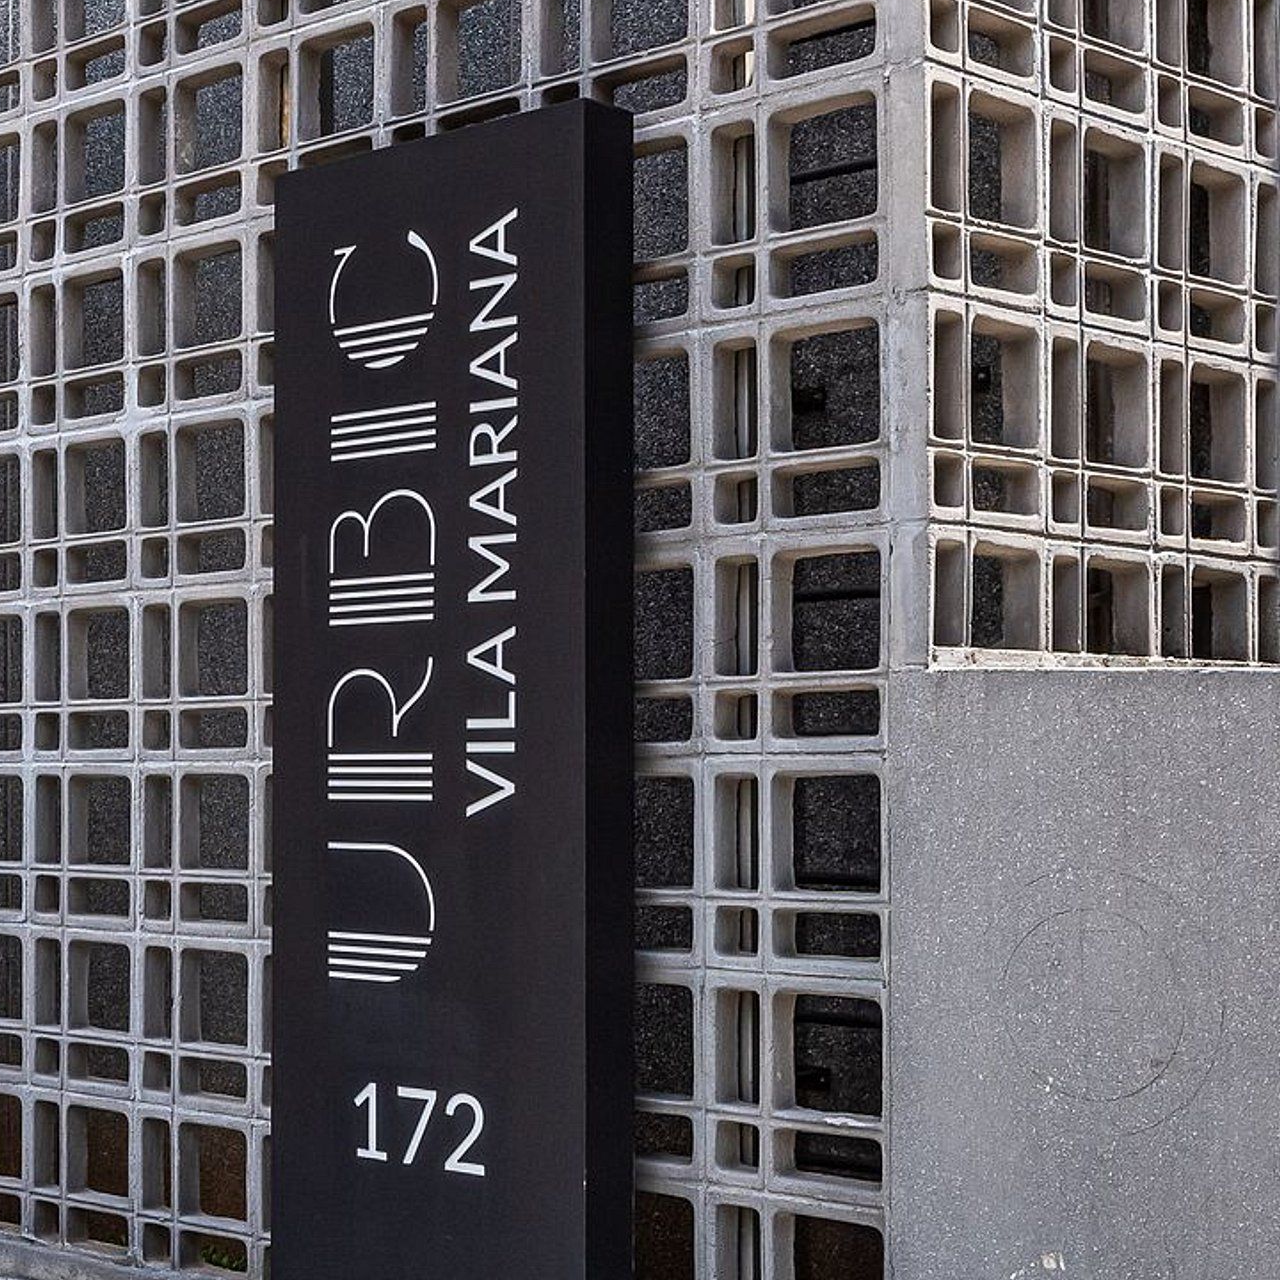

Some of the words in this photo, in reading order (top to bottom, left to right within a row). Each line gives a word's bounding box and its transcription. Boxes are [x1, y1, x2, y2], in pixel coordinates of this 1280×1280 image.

[468, 208, 518, 602] MARIANA
[328, 231, 438, 983] URBIC
[466, 626, 517, 818] VILA
[354, 1083, 486, 1176] 172
